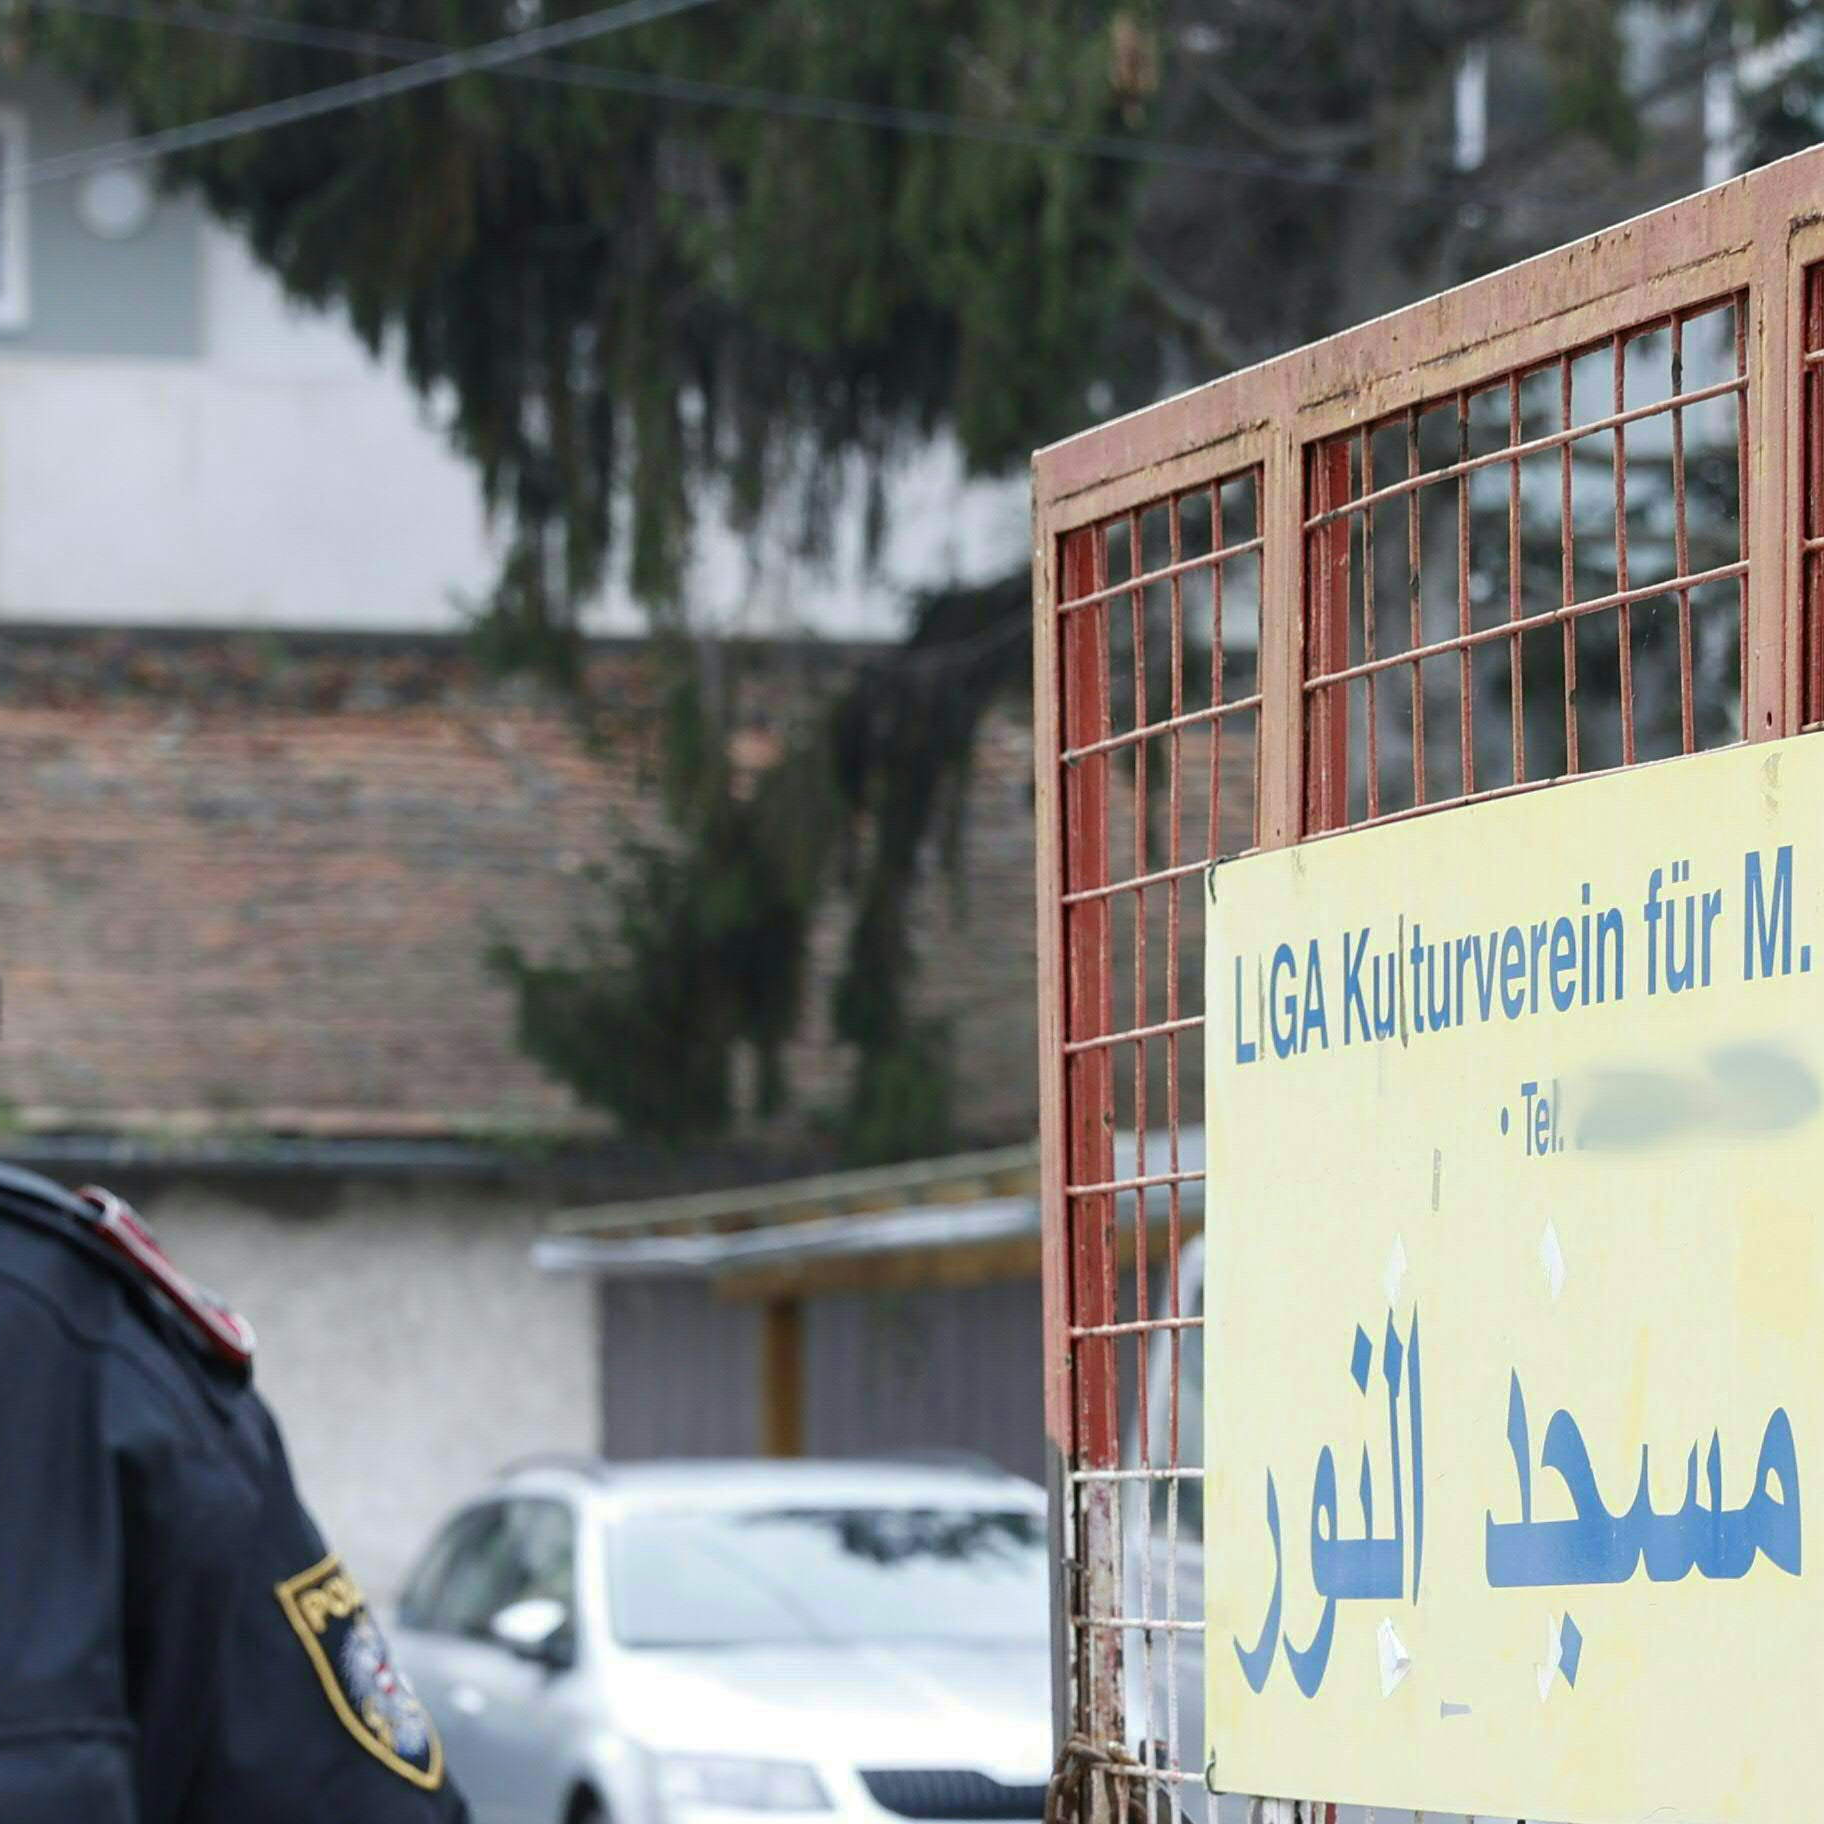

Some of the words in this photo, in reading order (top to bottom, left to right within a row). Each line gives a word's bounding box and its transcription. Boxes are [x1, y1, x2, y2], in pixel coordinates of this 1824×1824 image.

[1234, 938, 1330, 1065] LIGA
[1342, 882, 1626, 1049] Kulturverein
[1643, 860, 1723, 996] für
[1743, 845, 1813, 982] M.
[1485, 1366, 1804, 1688] مسجد
